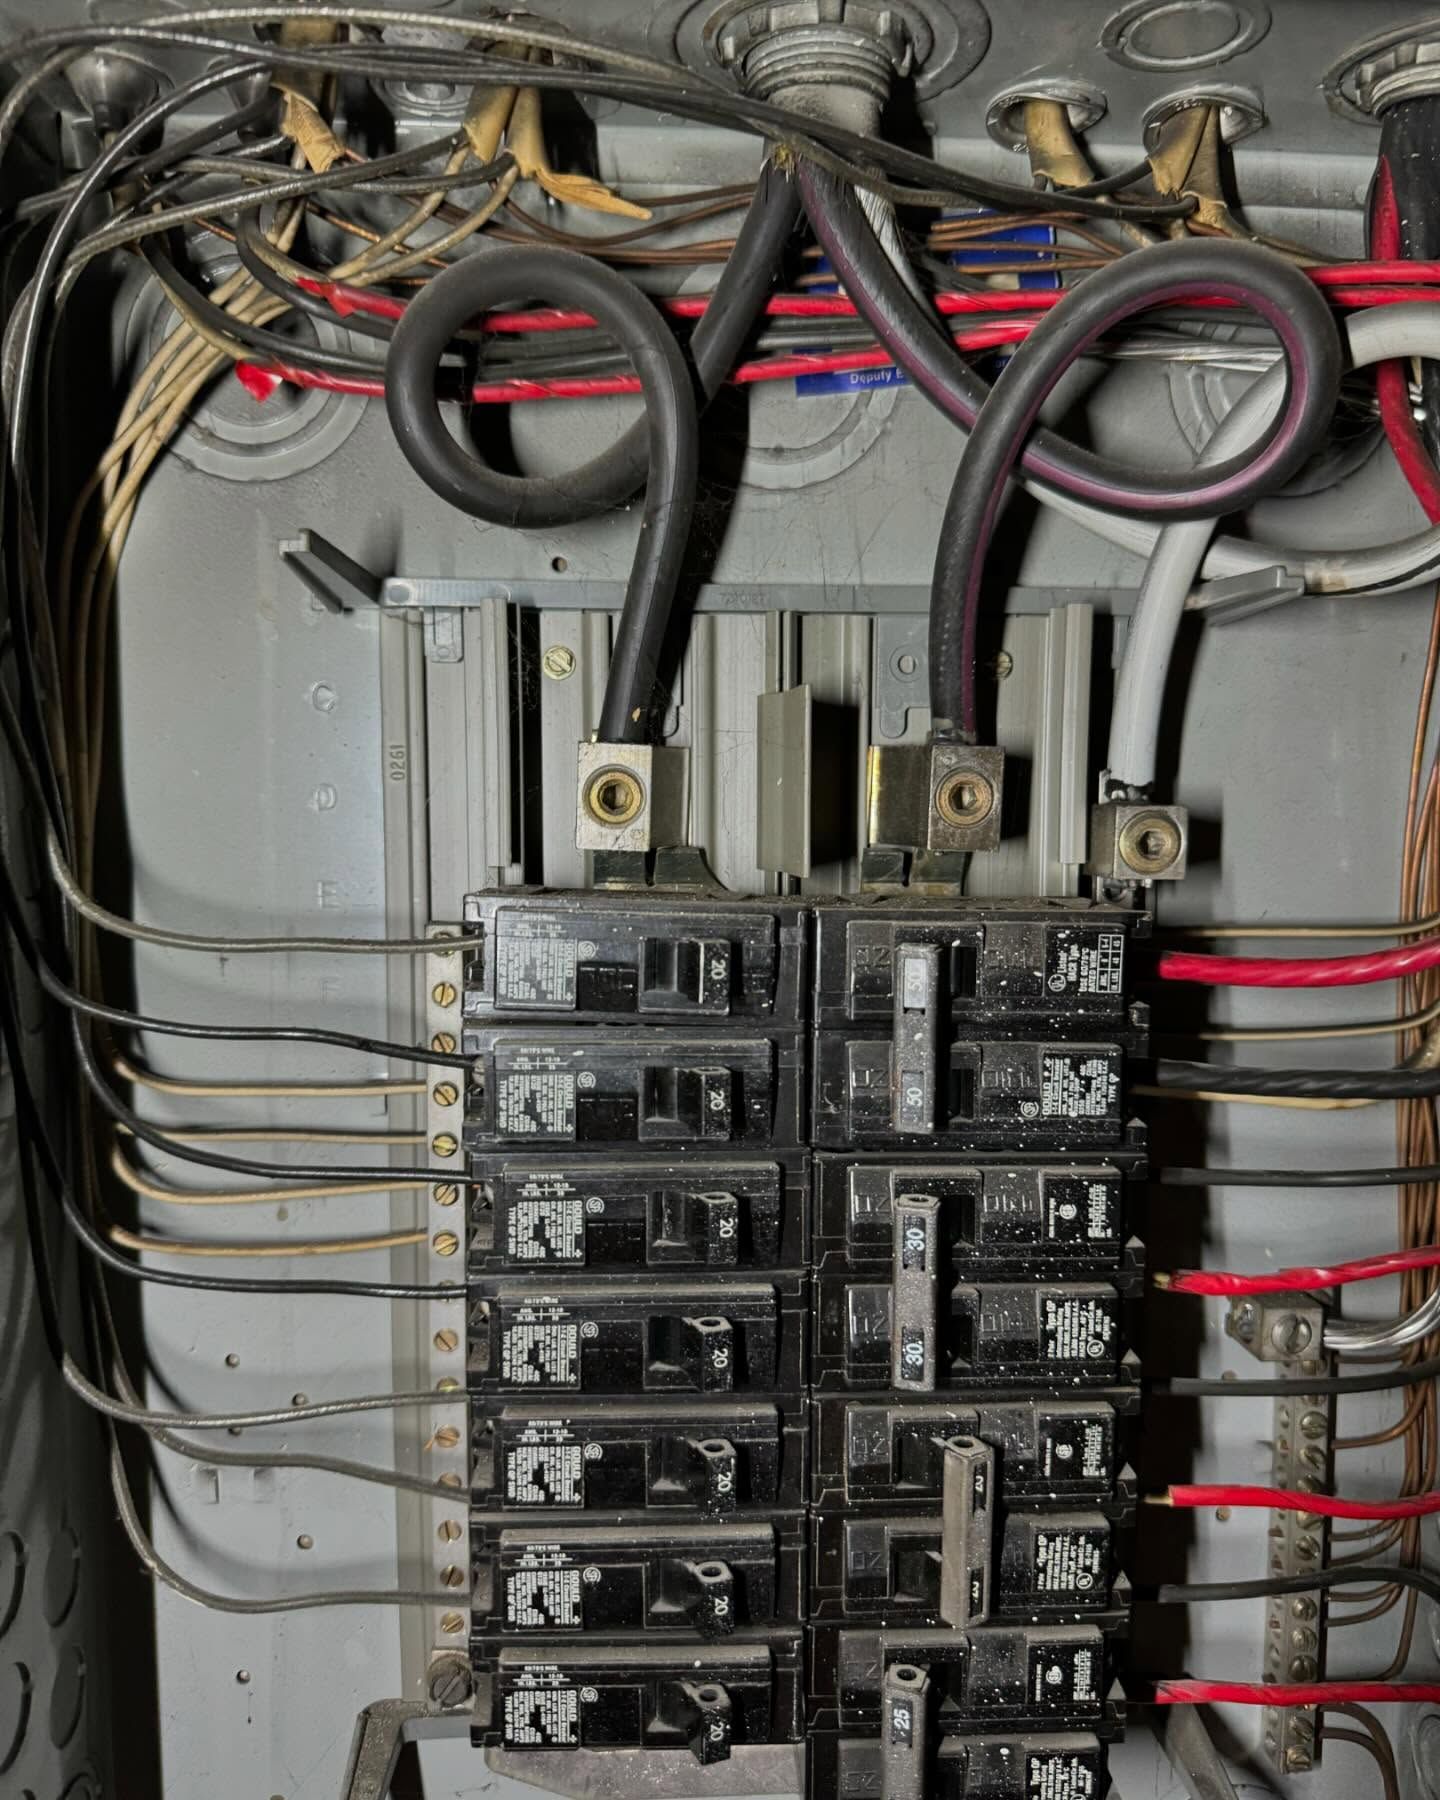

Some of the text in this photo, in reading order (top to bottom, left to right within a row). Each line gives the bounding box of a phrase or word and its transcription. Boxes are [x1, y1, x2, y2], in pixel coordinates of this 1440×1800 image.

[711, 960, 726, 980] 20
[710, 1091, 726, 1111] 20
[906, 1086, 922, 1107] 50
[719, 1218, 734, 1238] 20
[906, 1227, 926, 1252] 30
[713, 1348, 728, 1368] 20
[905, 1342, 924, 1365] 30
[718, 1471, 732, 1494] 20
[714, 1596, 729, 1616] 20
[893, 1708, 910, 1731] 25
[710, 1722, 725, 1742] 20
